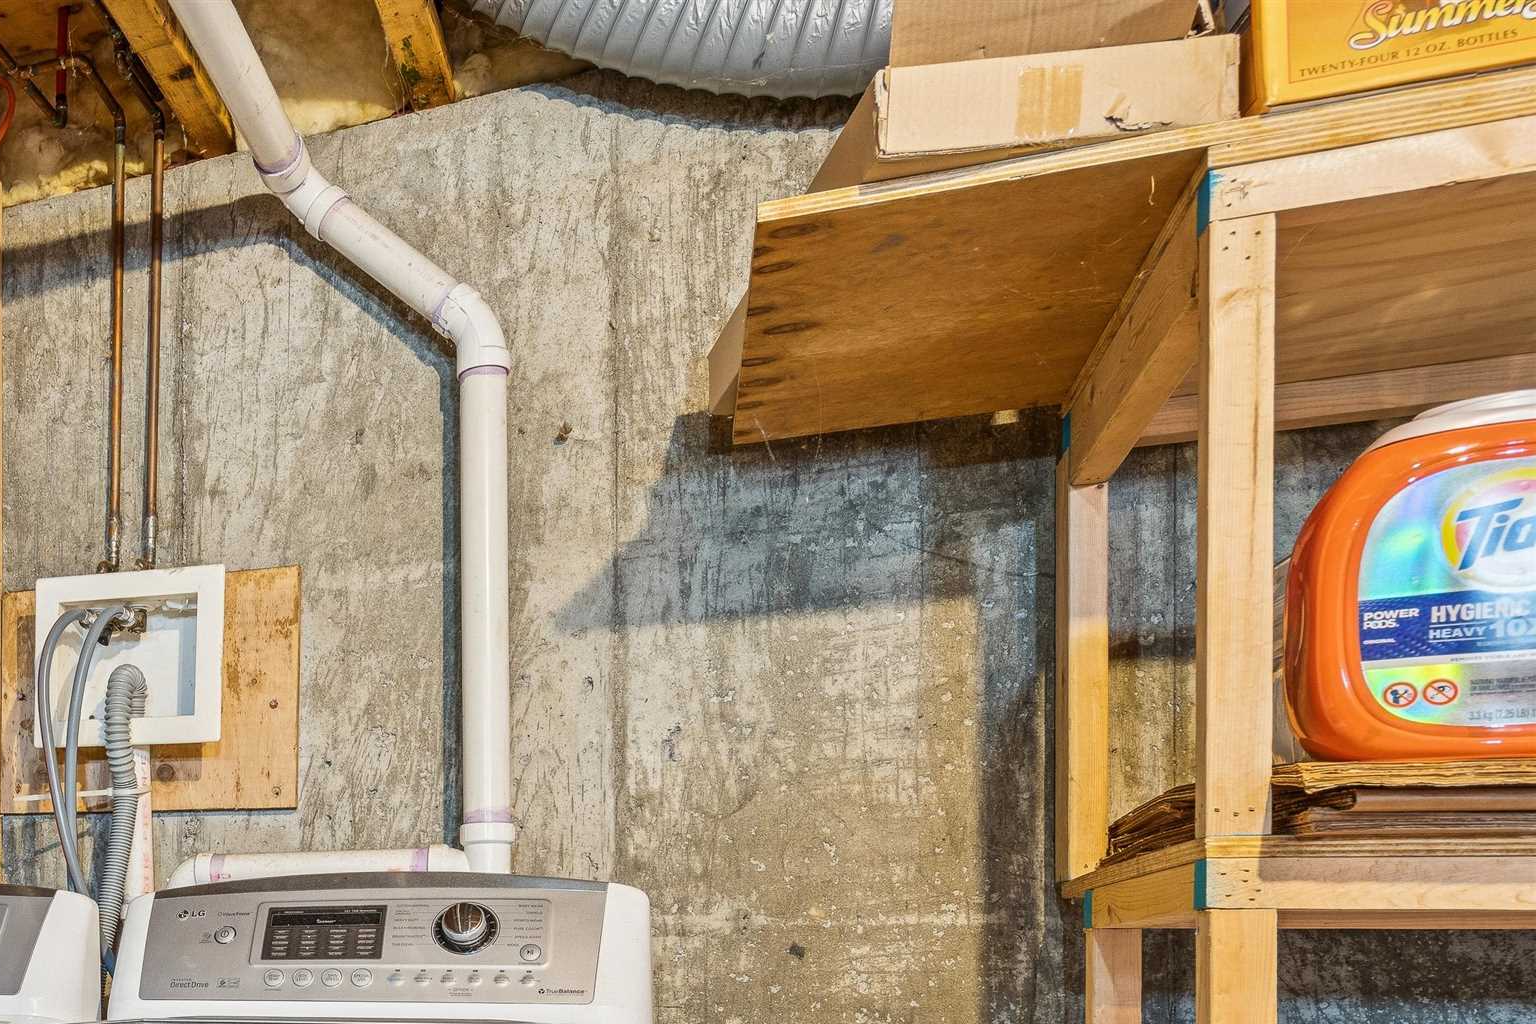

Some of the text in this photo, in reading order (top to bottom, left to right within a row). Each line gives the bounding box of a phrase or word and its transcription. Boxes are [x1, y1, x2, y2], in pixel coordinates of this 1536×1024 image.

[1299, 51, 1400, 77] TWENTY-FOUR
[1405, 48, 1420, 58] 12
[1457, 28, 1519, 49] BOTTLES
[1364, 607, 1420, 622] POWER
[1430, 600, 1530, 623] HYGIENIC
[1428, 626, 1486, 640] HEAVY
